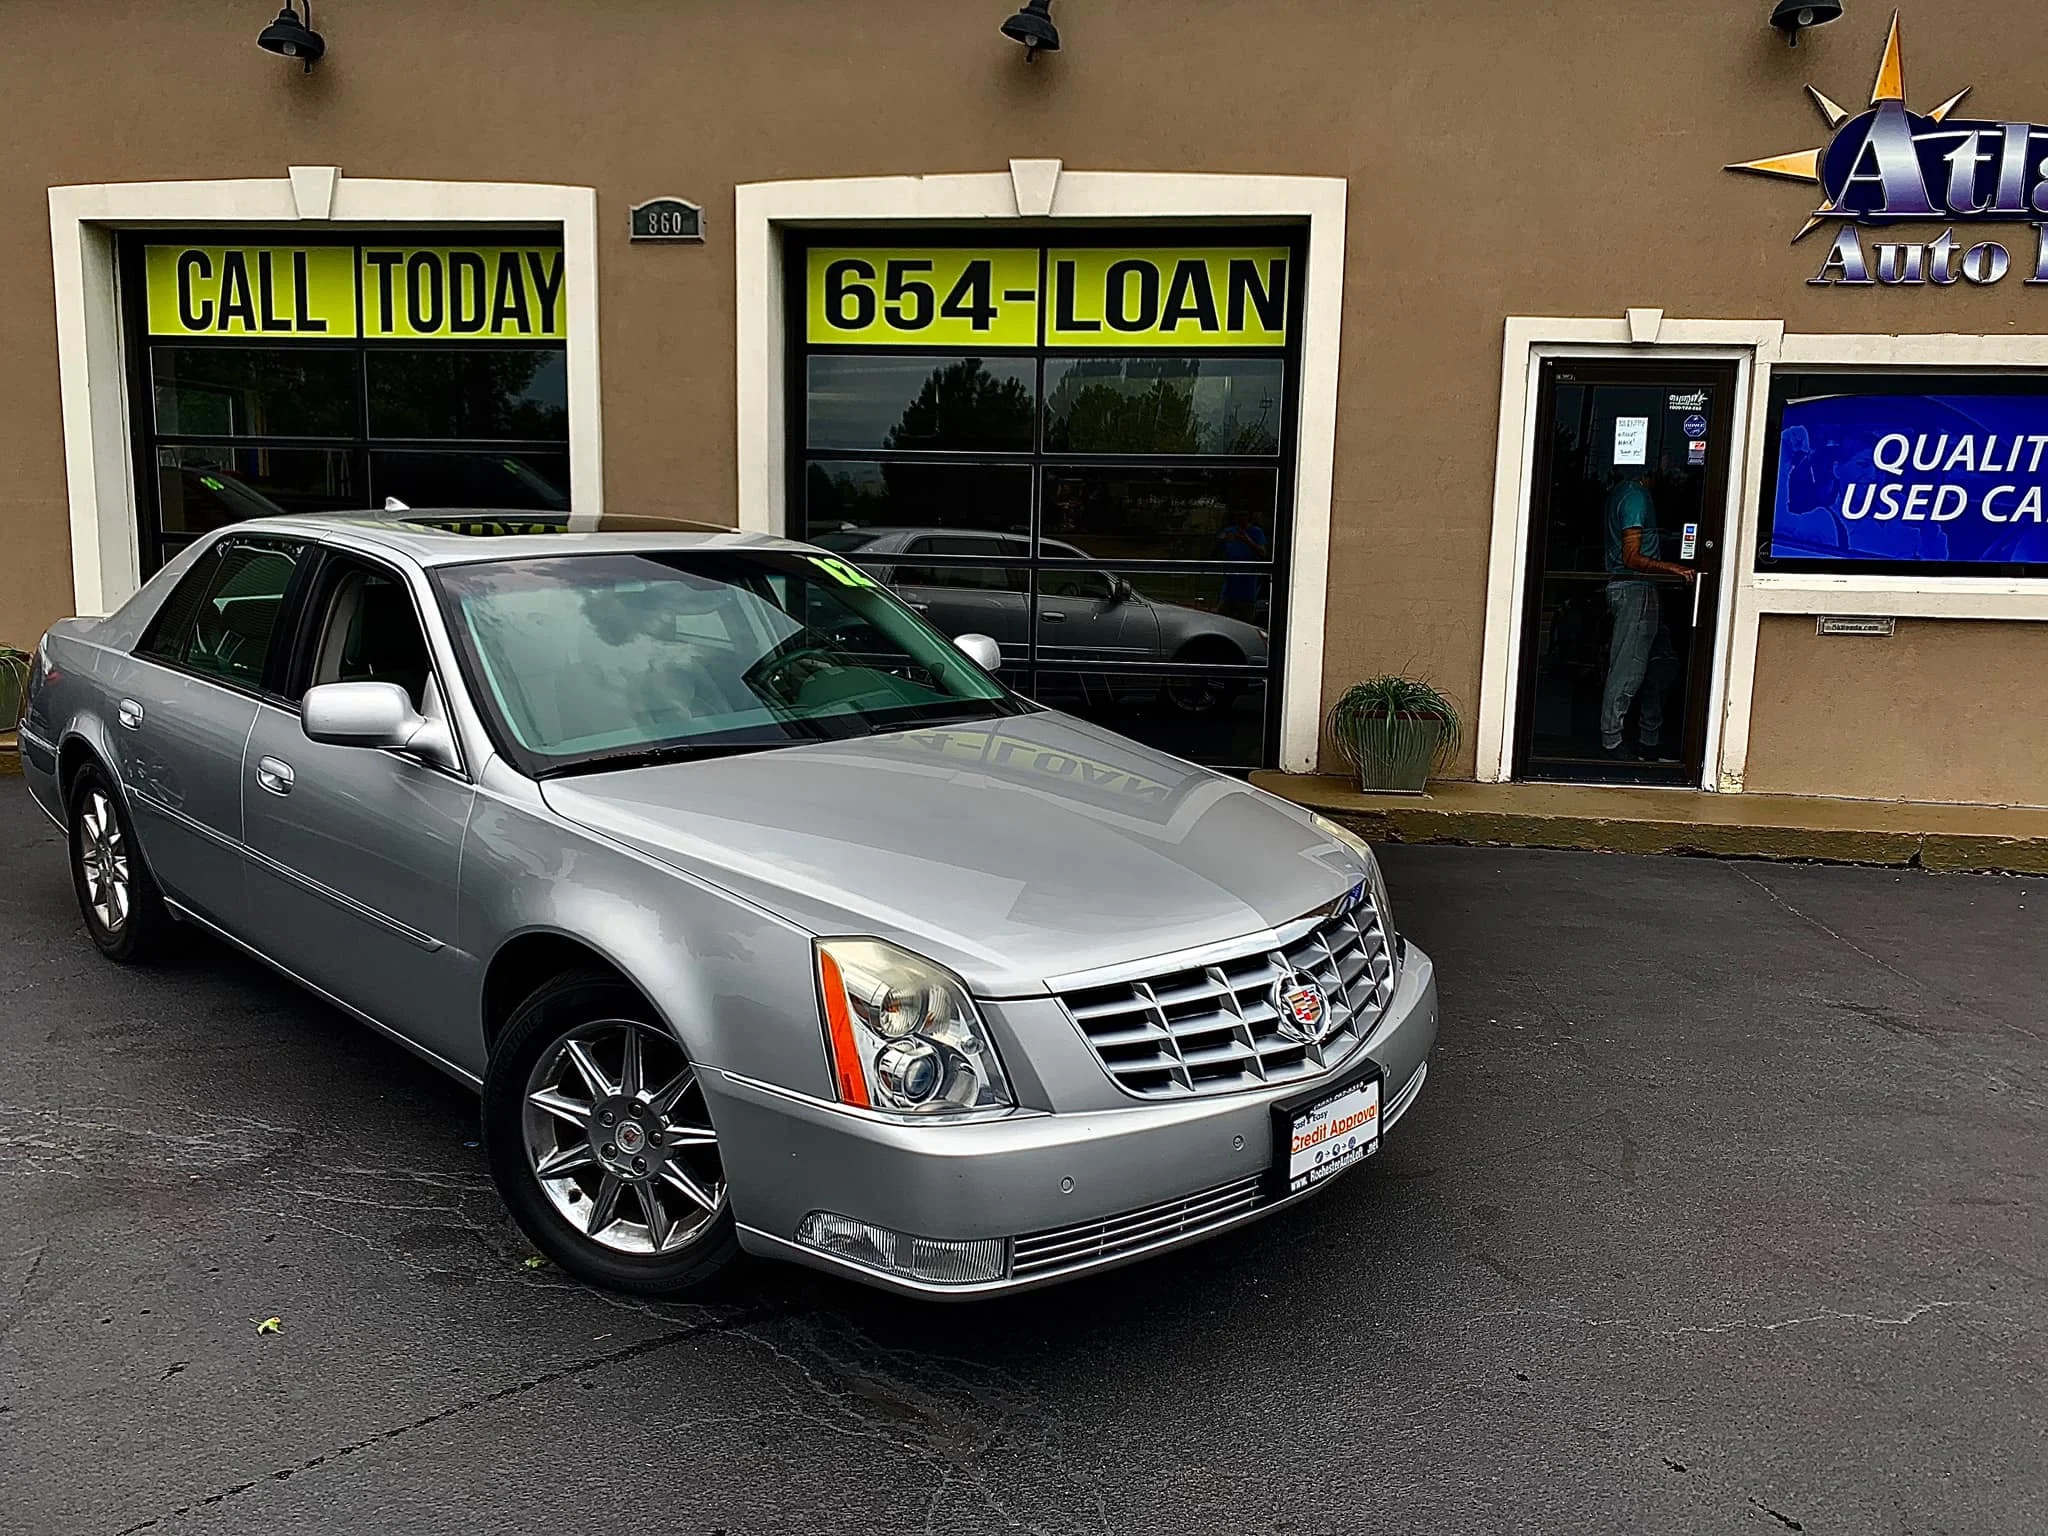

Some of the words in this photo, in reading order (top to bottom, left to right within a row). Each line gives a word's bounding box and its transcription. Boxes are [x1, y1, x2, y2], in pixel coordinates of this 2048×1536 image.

[648, 212, 681, 234] 860
[1806, 224, 2011, 285] Auto
[177, 249, 328, 332] CALL
[366, 249, 566, 335] TODAY
[1841, 483, 1968, 520] USED
[1981, 485, 2048, 522] CA
[1292, 1123, 1328, 1152] Credit
